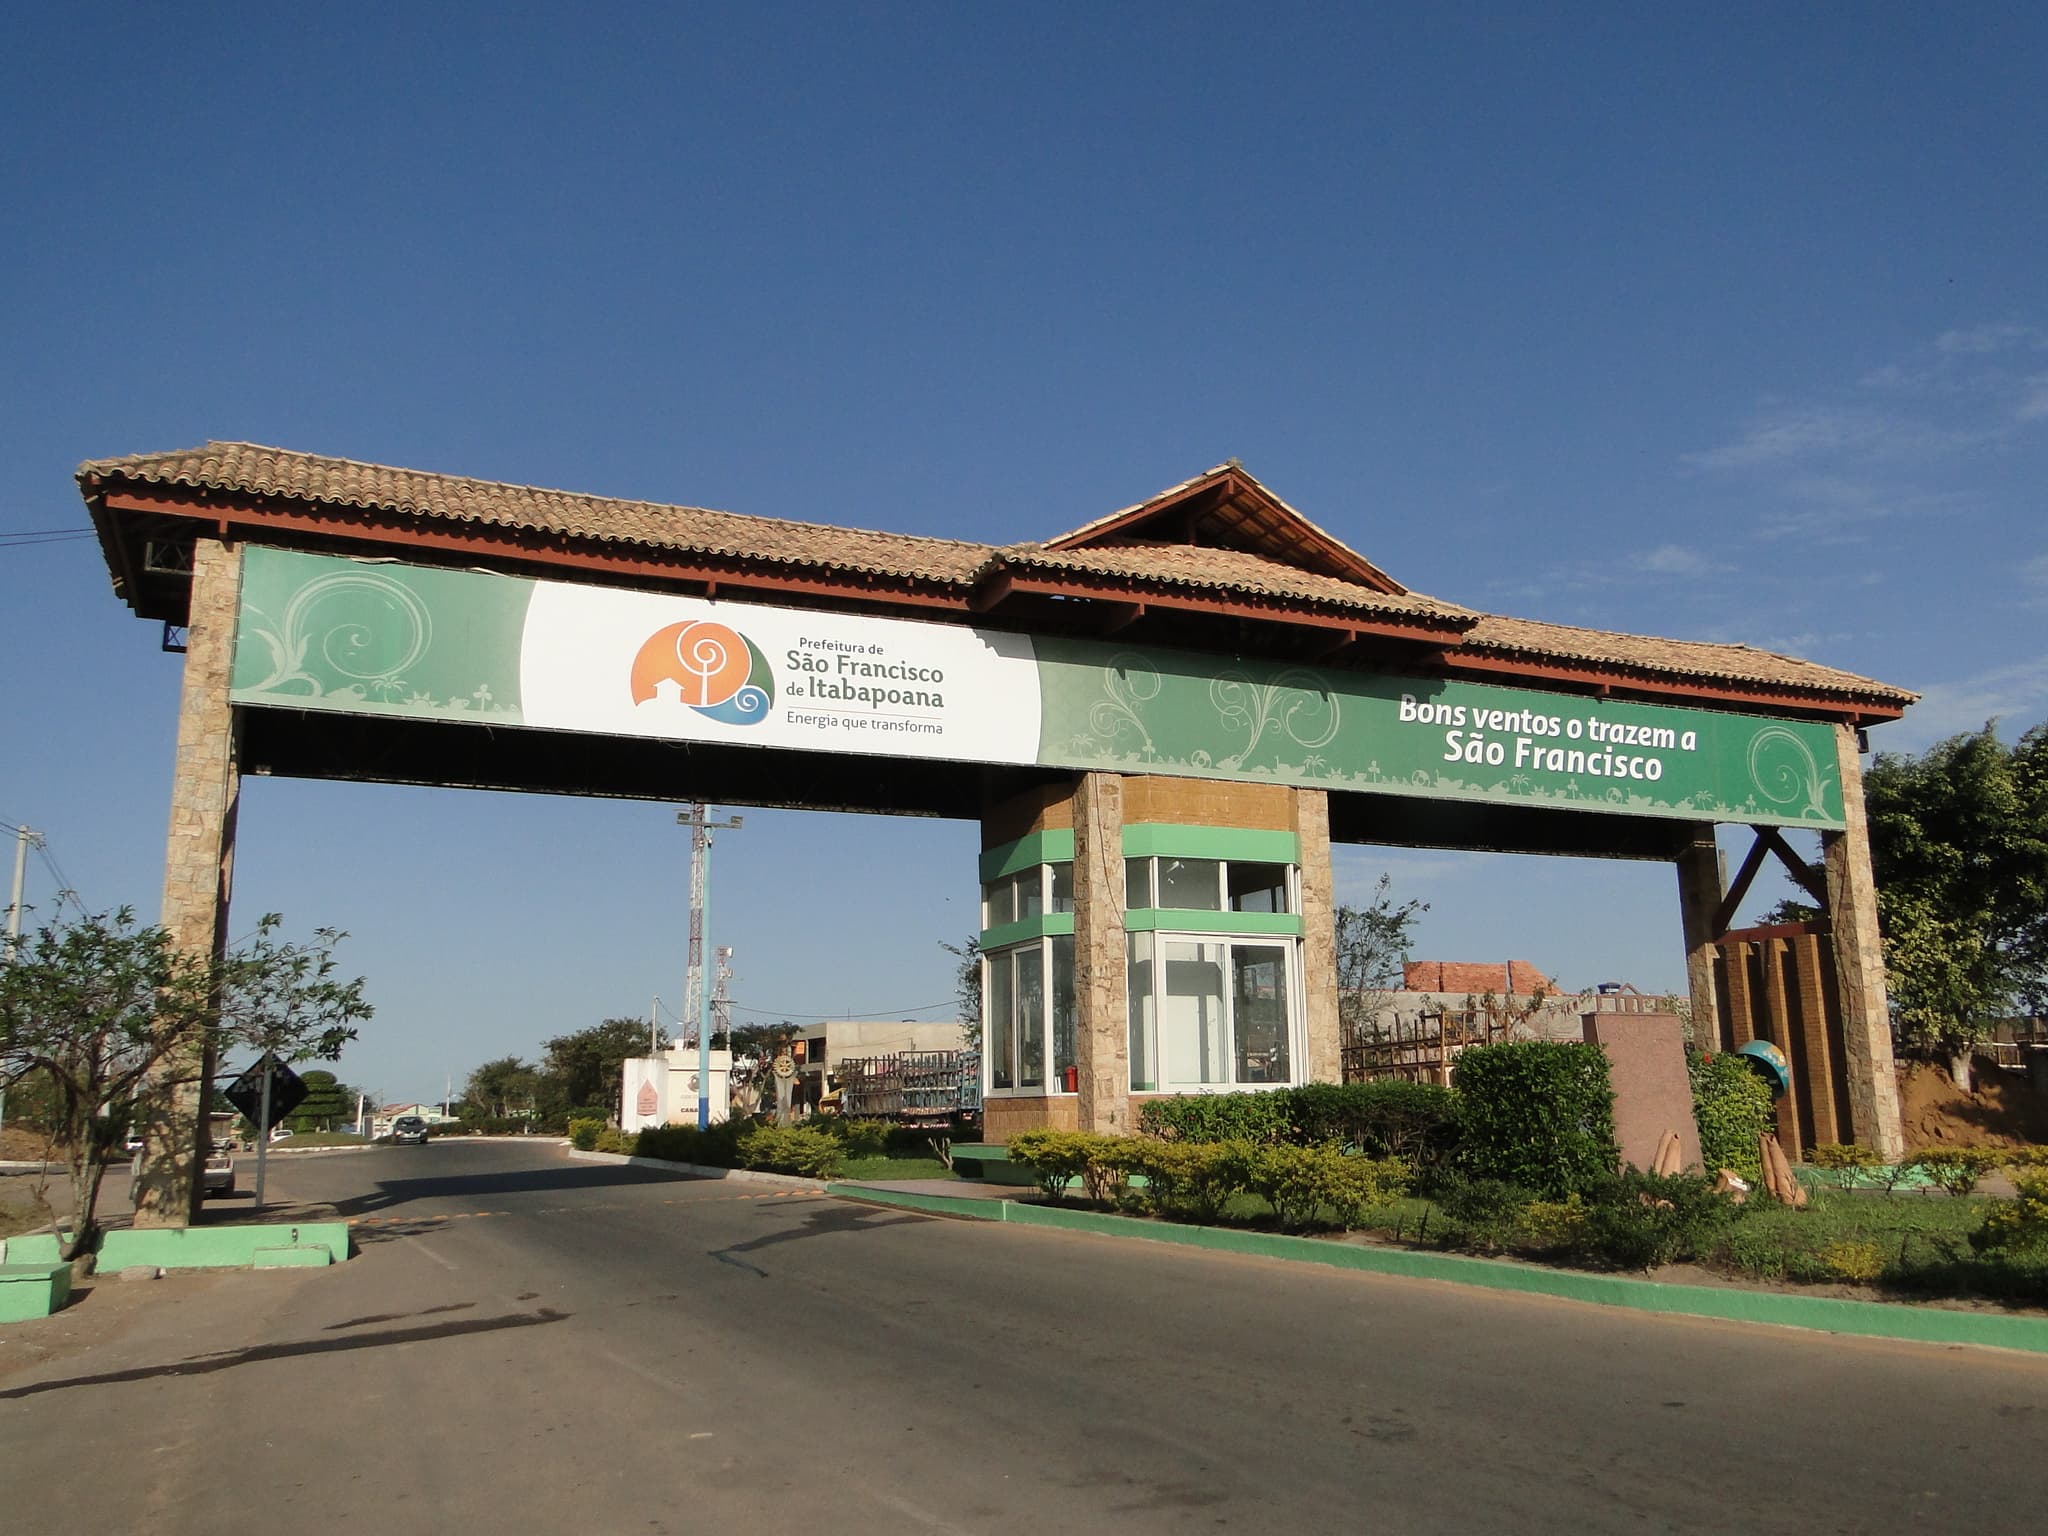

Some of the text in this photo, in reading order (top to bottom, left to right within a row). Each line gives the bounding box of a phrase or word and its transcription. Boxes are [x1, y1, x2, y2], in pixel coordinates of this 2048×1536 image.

[799, 637, 884, 655] Prefeitura de
[786, 650, 944, 683] São Francisco
[786, 676, 944, 709] de Itabapoana
[787, 711, 943, 734] Energia que transforma
[1400, 694, 1697, 751] Bons ventos o trazem a
[1444, 730, 1662, 781] São Francisco
